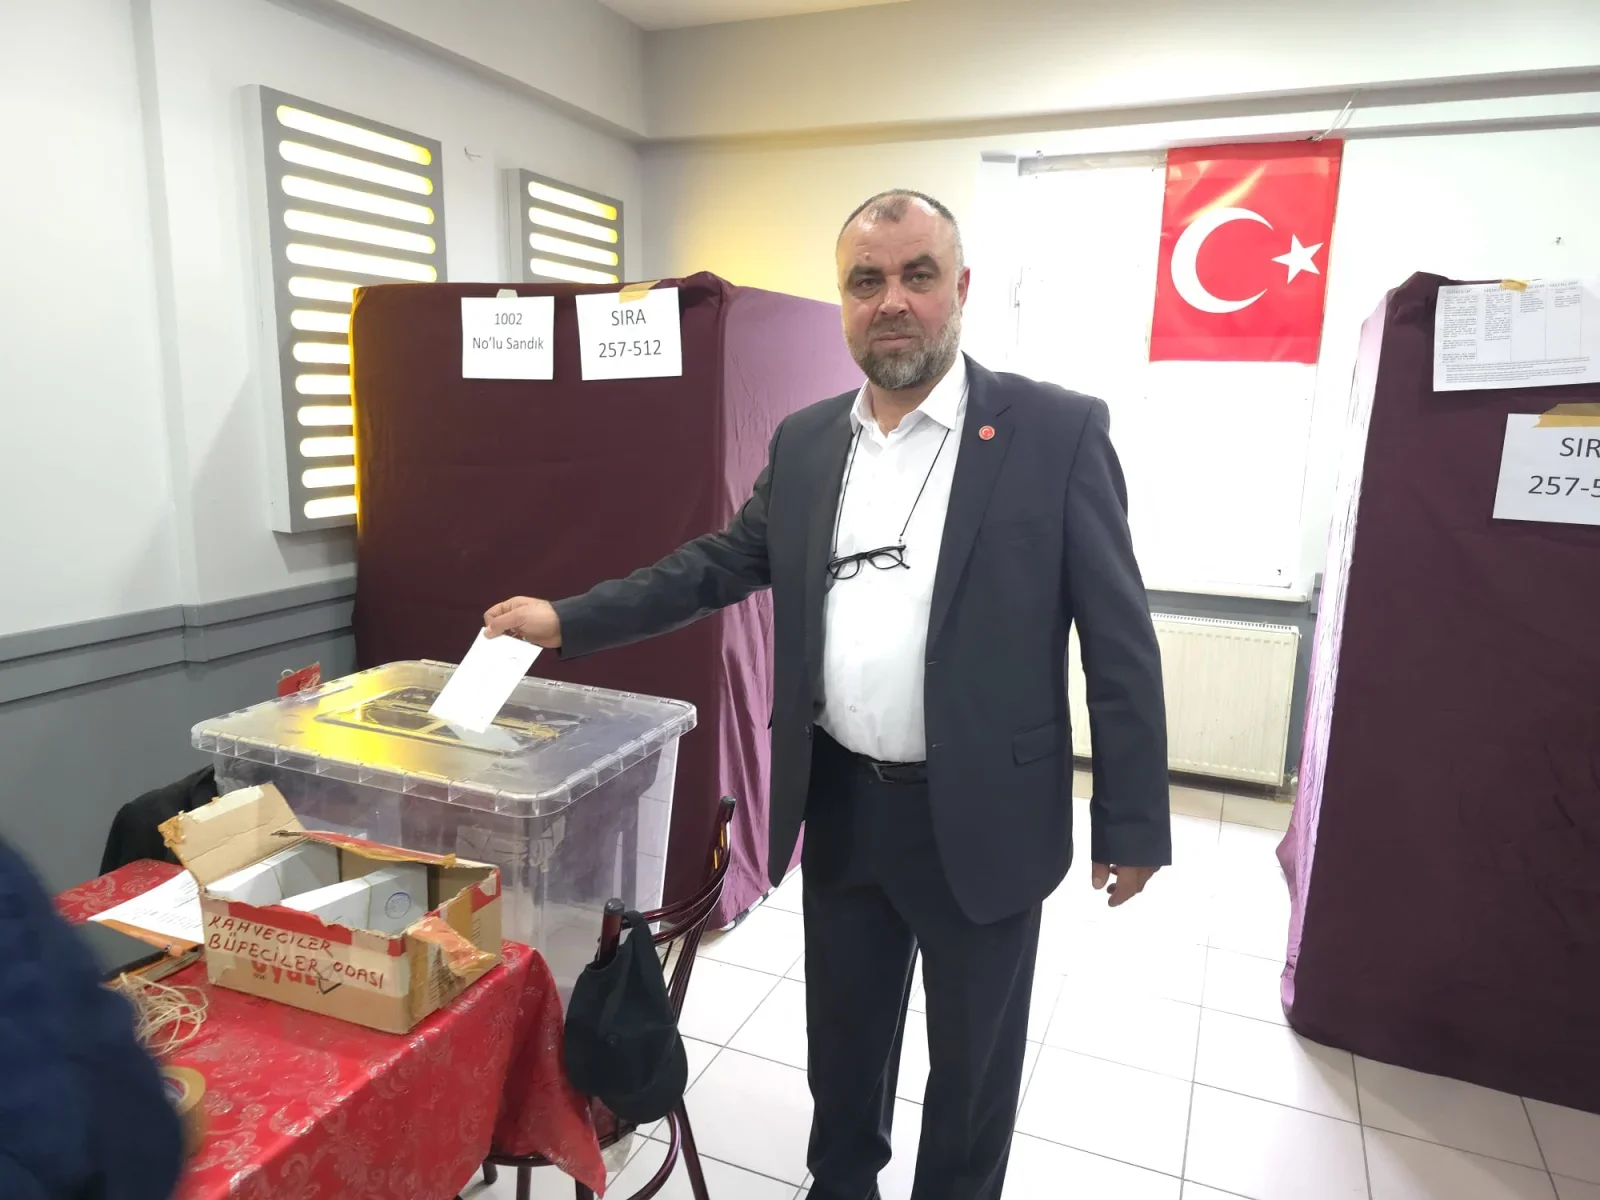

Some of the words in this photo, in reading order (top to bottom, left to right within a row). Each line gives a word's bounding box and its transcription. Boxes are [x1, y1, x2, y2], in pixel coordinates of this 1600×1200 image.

[494, 312, 523, 326] 1002
[610, 308, 647, 327] SIRA
[506, 336, 544, 350] Sandık
[598, 339, 662, 359] 257-512
[333, 961, 384, 990] ODASI
